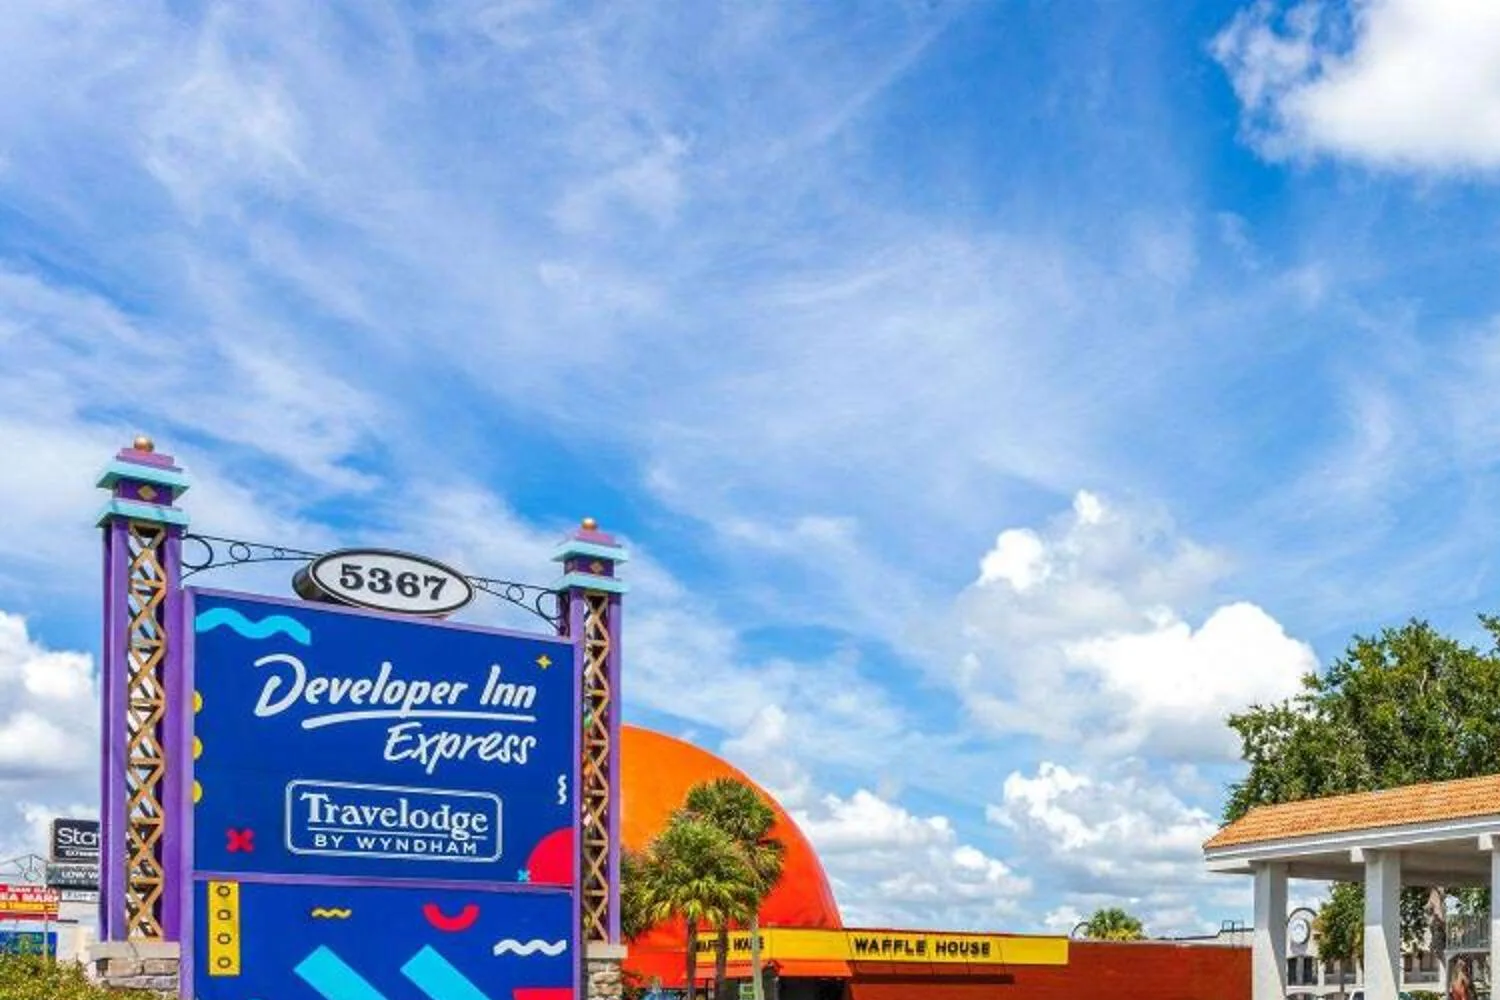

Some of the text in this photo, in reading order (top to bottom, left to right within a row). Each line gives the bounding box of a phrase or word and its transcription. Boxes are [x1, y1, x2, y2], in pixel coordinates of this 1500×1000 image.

[338, 562, 447, 601] 5367
[253, 654, 537, 718] Developer Inn
[383, 721, 537, 775] Express
[299, 792, 489, 840] Travelodge
[57, 827, 99, 846] Sta
[314, 834, 478, 855] BY WYNDHAM
[733, 936, 764, 951] HOUE
[854, 938, 991, 956] WAFFLE HOUSE
